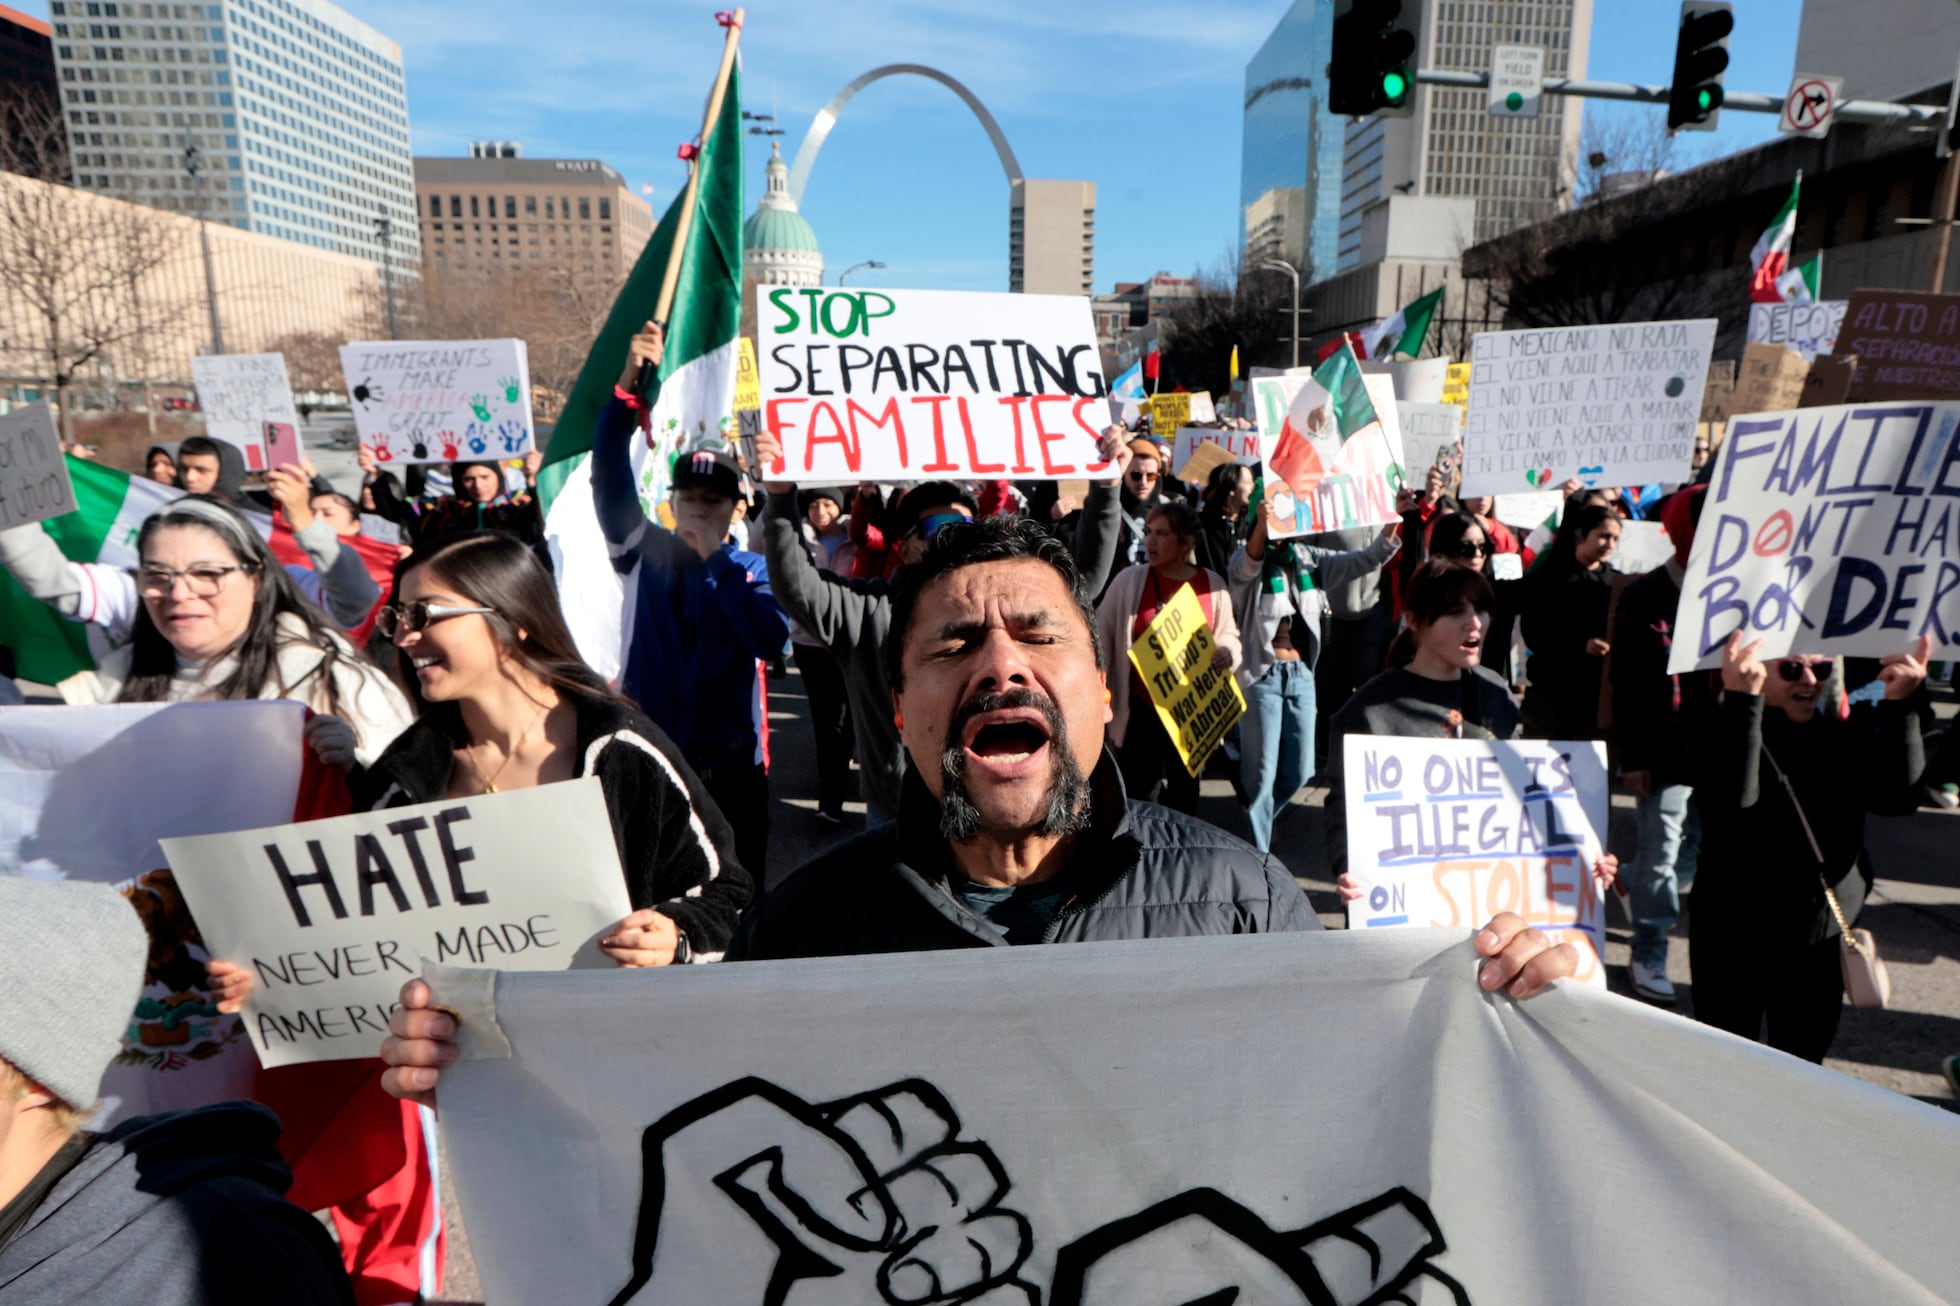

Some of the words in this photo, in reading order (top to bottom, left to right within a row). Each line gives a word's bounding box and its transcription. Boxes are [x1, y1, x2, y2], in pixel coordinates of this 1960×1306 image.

[1504, 62, 1532, 75] YIELD
[769, 288, 896, 338] STOP
[1854, 302, 1928, 333] ALTO
[1938, 304, 1958, 336] A
[360, 347, 492, 372] IMMIGRANTS
[1474, 336, 1500, 361] EL
[1510, 329, 1599, 356] MEXICANO
[1609, 326, 1635, 350] NO
[1641, 324, 1688, 348] RAJA
[398, 369, 459, 390] MAKE
[771, 339, 1106, 399] SEPARATING
[1473, 363, 1499, 385] EL
[1507, 359, 1555, 381] VIENE
[1561, 353, 1600, 375] AQUI
[1603, 354, 1614, 373] A
[1621, 351, 1700, 373] TRABAJAR
[382, 390, 471, 410] AMERICA
[1472, 388, 1498, 410] EL
[1500, 384, 1522, 406] NO
[1529, 381, 1579, 405] VIENE
[1585, 379, 1598, 400] A
[1604, 376, 1655, 401] TIRAR
[388, 410, 453, 432] GREAT
[766, 394, 1111, 476] FAMILIES
[1471, 413, 1494, 434] EL
[1499, 410, 1520, 430] NO
[1526, 407, 1575, 428] VIENE
[1621, 403, 1633, 422] A
[1641, 401, 1694, 421] MATAR
[1468, 434, 1491, 455] EL
[1497, 429, 1546, 451] VIENE
[1554, 429, 1565, 447] A
[1661, 422, 1695, 441] LOMO
[1466, 455, 1491, 476] EN
[1501, 455, 1518, 472] EL
[1523, 451, 1567, 469] CAMPO
[1576, 449, 1585, 466] Y
[1590, 446, 1609, 465] EN
[1613, 445, 1629, 464] LA
[1148, 608, 1183, 660] STOP
[1153, 630, 1209, 699] Trump's
[1170, 694, 1198, 729] War
[1191, 663, 1223, 700] Here
[1190, 676, 1234, 742] Abroad
[1364, 750, 1402, 793] NO
[1423, 754, 1502, 794] ONE
[1523, 752, 1575, 794] IS
[1375, 800, 1584, 860] ILLEGAL
[264, 806, 490, 928] HATE
[1369, 882, 1406, 913] ON
[1430, 857, 1597, 928] STOLEN
[252, 940, 414, 990] NEVER
[435, 914, 560, 964] MADE
